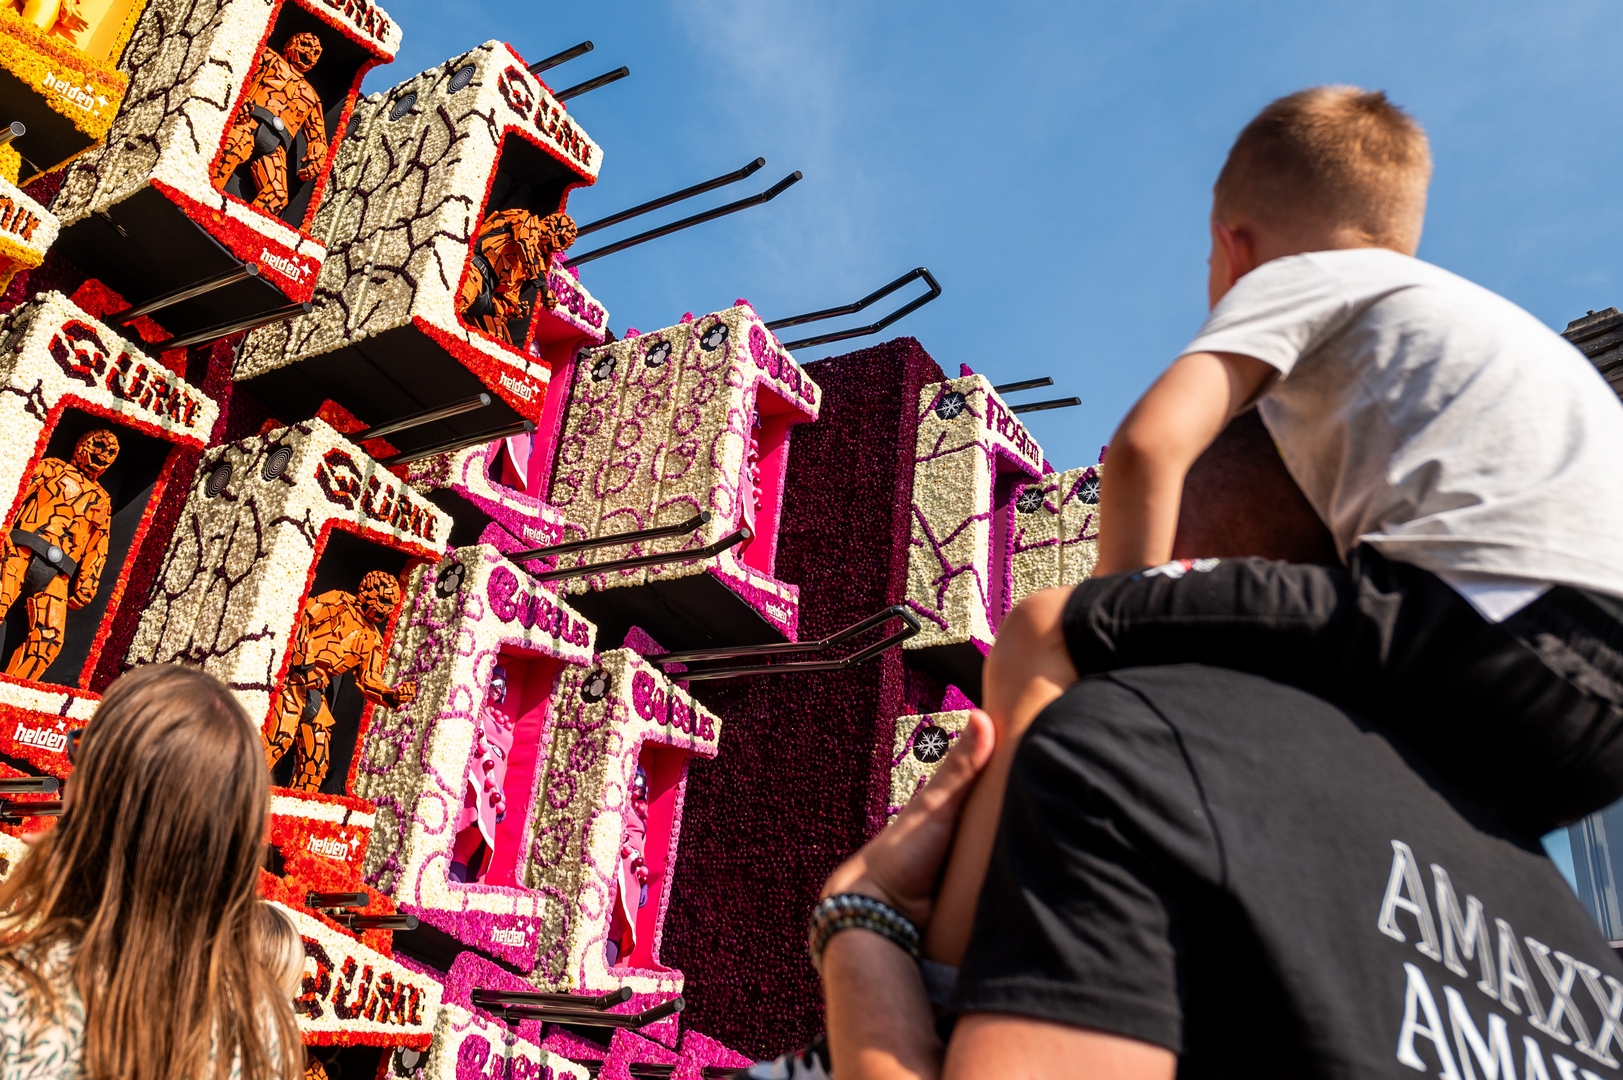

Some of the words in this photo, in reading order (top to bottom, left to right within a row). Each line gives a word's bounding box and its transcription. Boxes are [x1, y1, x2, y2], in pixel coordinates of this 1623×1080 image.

[43, 72, 95, 111] helden
[260, 247, 300, 282] helden
[499, 371, 532, 402] helden
[523, 524, 551, 547] helden
[13, 722, 68, 753] helden
[306, 833, 349, 861] helden
[491, 925, 526, 947] helden
